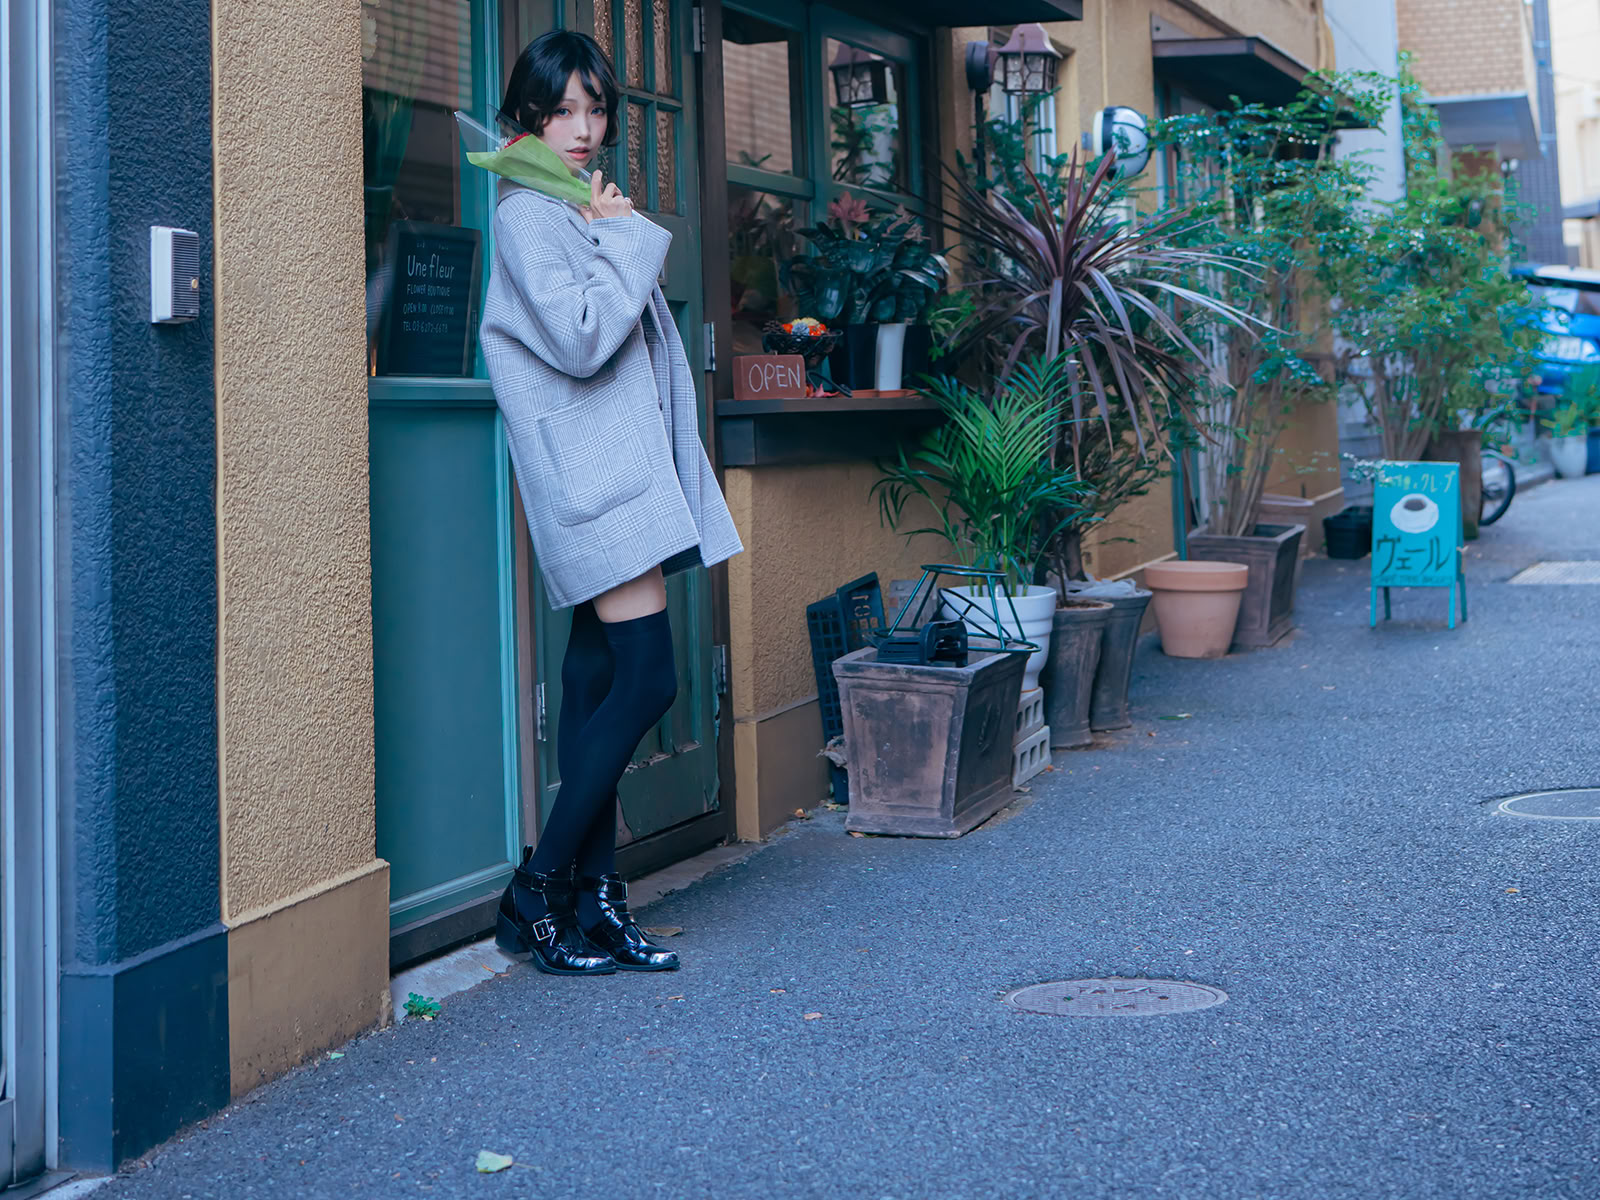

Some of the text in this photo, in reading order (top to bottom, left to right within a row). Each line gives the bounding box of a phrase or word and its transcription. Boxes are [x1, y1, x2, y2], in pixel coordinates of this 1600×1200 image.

[407, 253, 455, 279] Une fleur
[406, 283, 451, 297] FLOWER BOUTIQUE
[749, 362, 801, 393] OPEN
[1376, 534, 1452, 576] ヴェール
